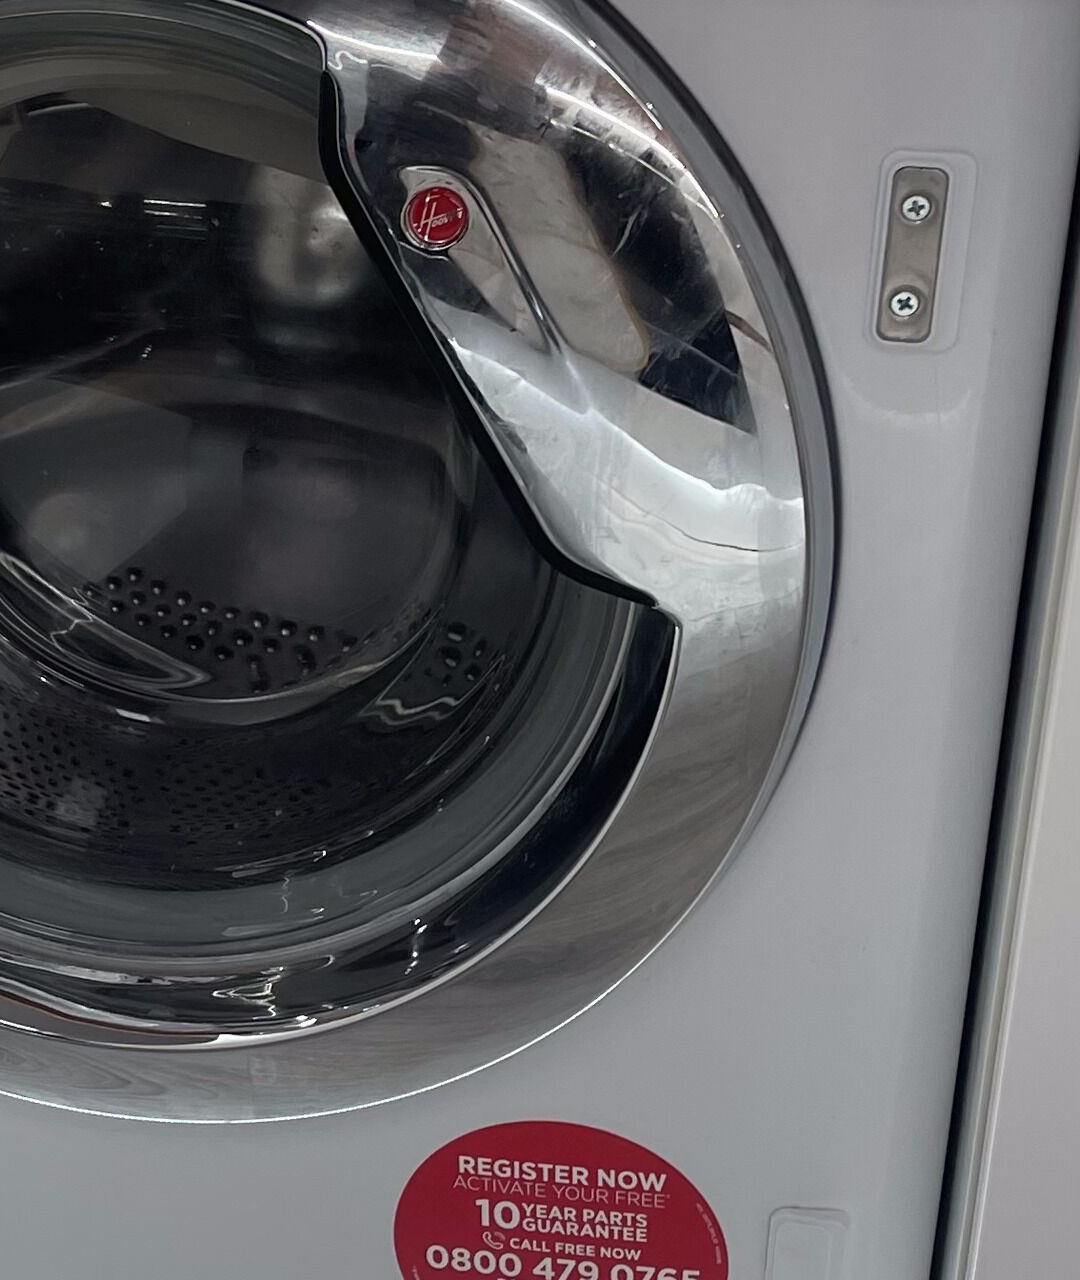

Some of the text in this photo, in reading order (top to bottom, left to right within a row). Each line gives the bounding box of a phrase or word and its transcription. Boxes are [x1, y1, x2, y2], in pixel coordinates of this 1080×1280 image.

[458, 1155, 667, 1192] REGISTER NOW
[453, 1175, 546, 1198] ACTIVATE
[552, 1184, 609, 1204] YOUR
[475, 1198, 648, 1229] 10 YEAR PARTS
[522, 1218, 648, 1243] GUARANTEE
[426, 1244, 522, 1277] 0800
[509, 1237, 642, 1261] CALL FREE NOW
